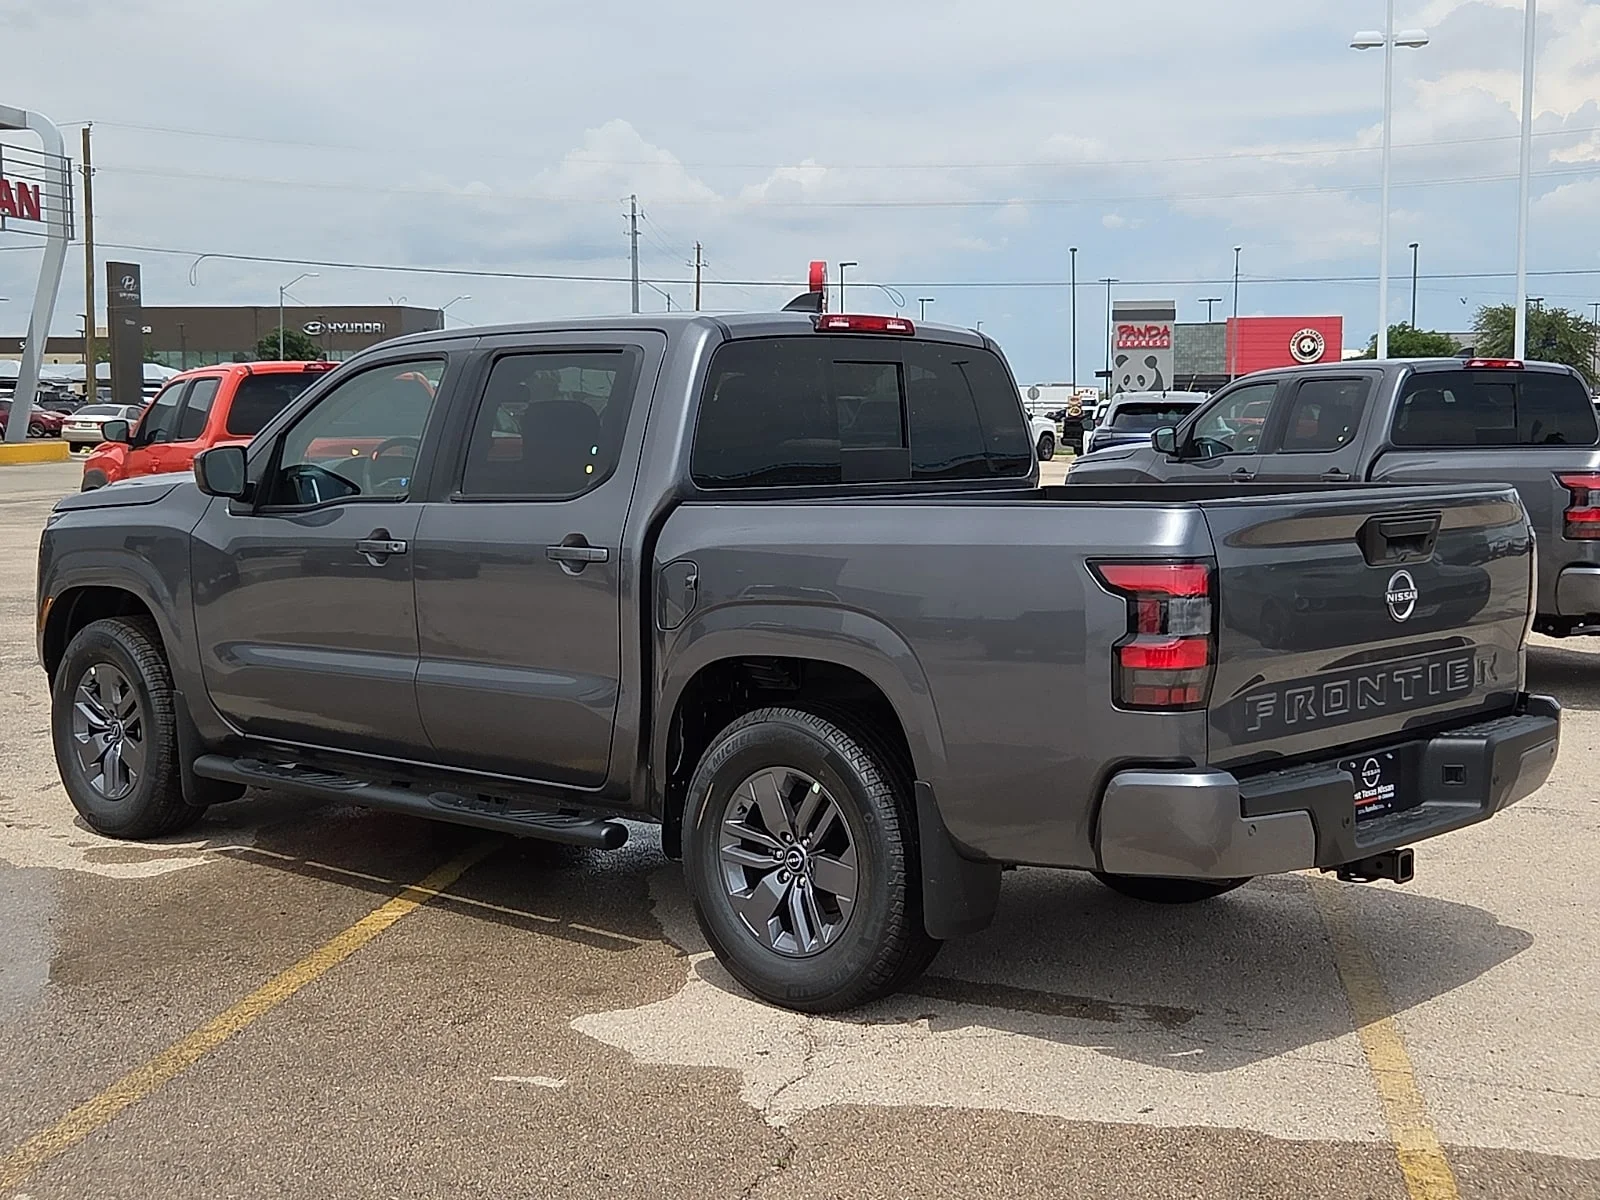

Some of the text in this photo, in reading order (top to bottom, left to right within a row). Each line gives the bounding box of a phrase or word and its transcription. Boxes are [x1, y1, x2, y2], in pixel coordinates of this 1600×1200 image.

[327, 322, 386, 333] HYUNDAI
[1117, 324, 1171, 340] PANDA
[1386, 591, 1418, 602] NISSAN
[1245, 652, 1499, 732] FRONTIER
[1361, 788, 1377, 797] Texas
[1377, 784, 1395, 794] Nissan
